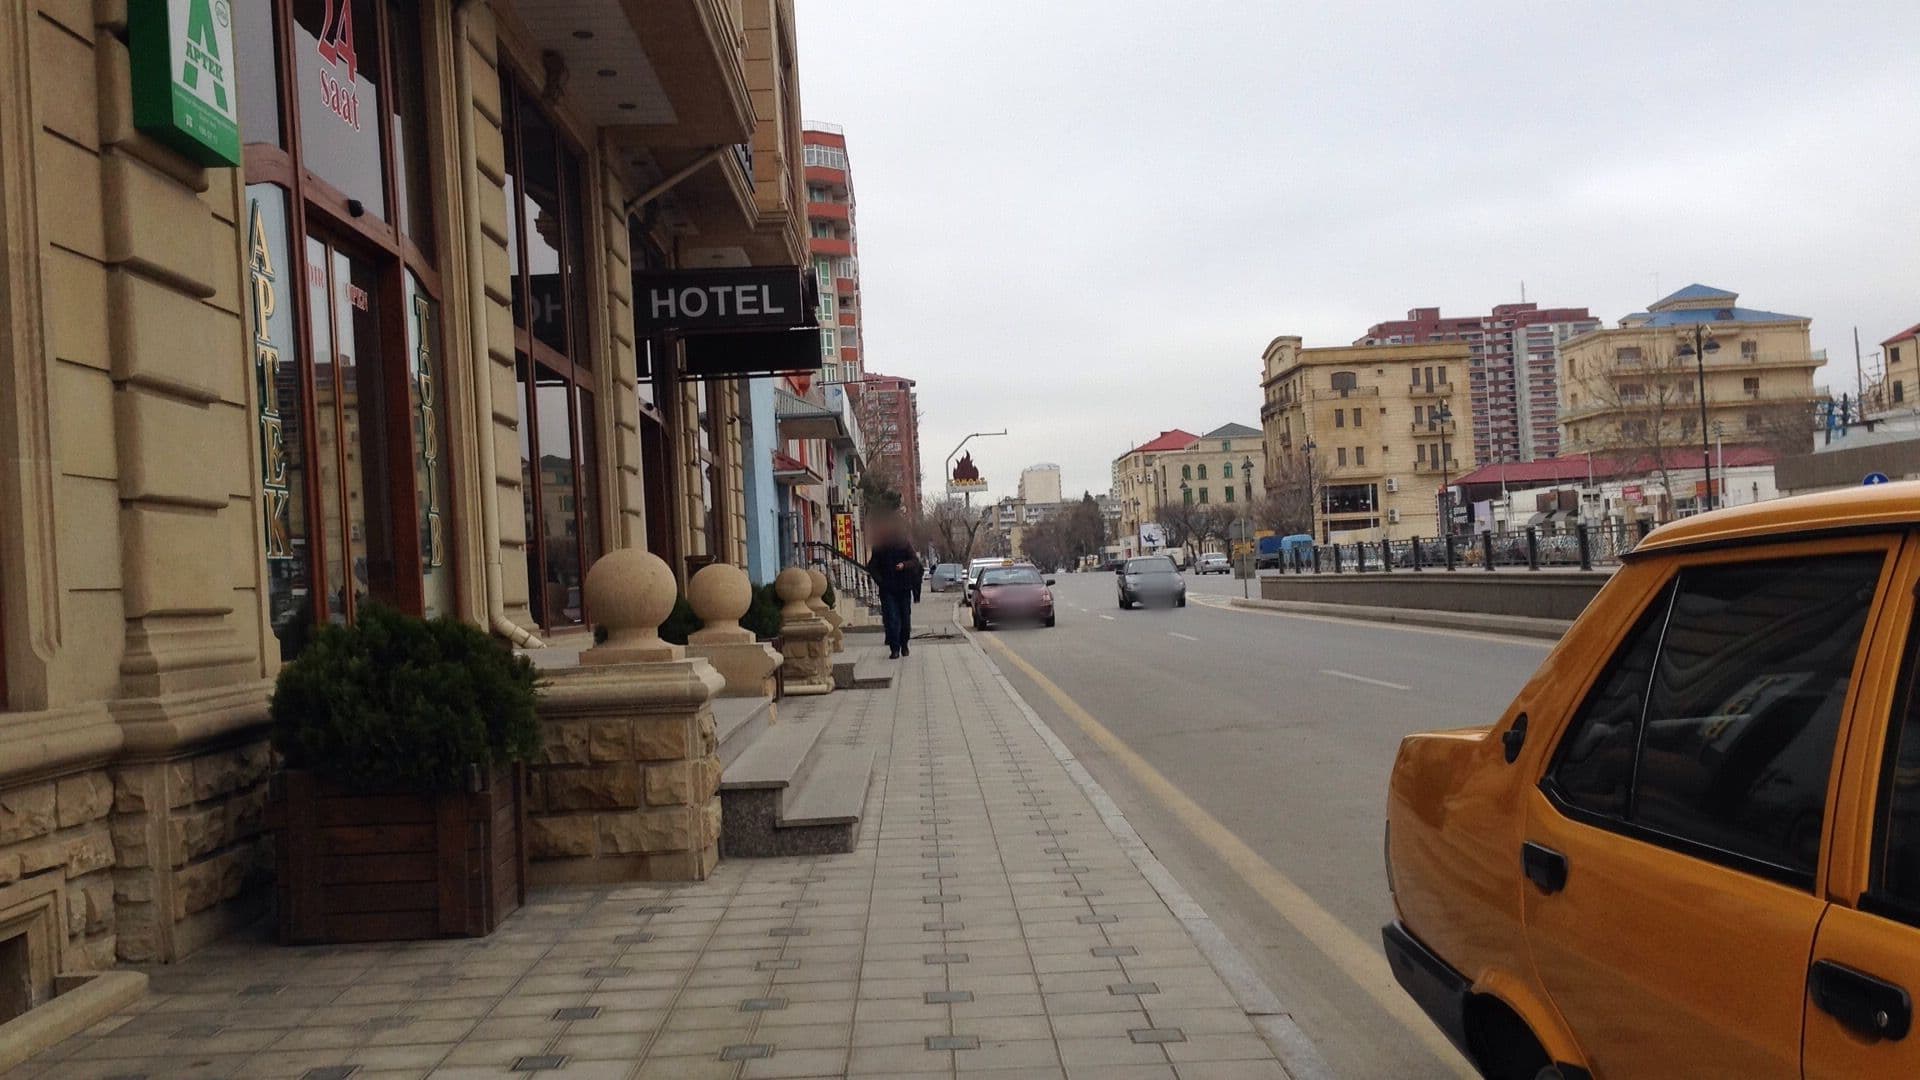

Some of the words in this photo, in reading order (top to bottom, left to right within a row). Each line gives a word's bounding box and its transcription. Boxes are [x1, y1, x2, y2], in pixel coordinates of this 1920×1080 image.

[186, 41, 224, 82] APTEK
[317, 0, 358, 86] 24
[319, 68, 361, 132] saat
[651, 284, 785, 319] HOTEL
[249, 198, 294, 560] APTEK
